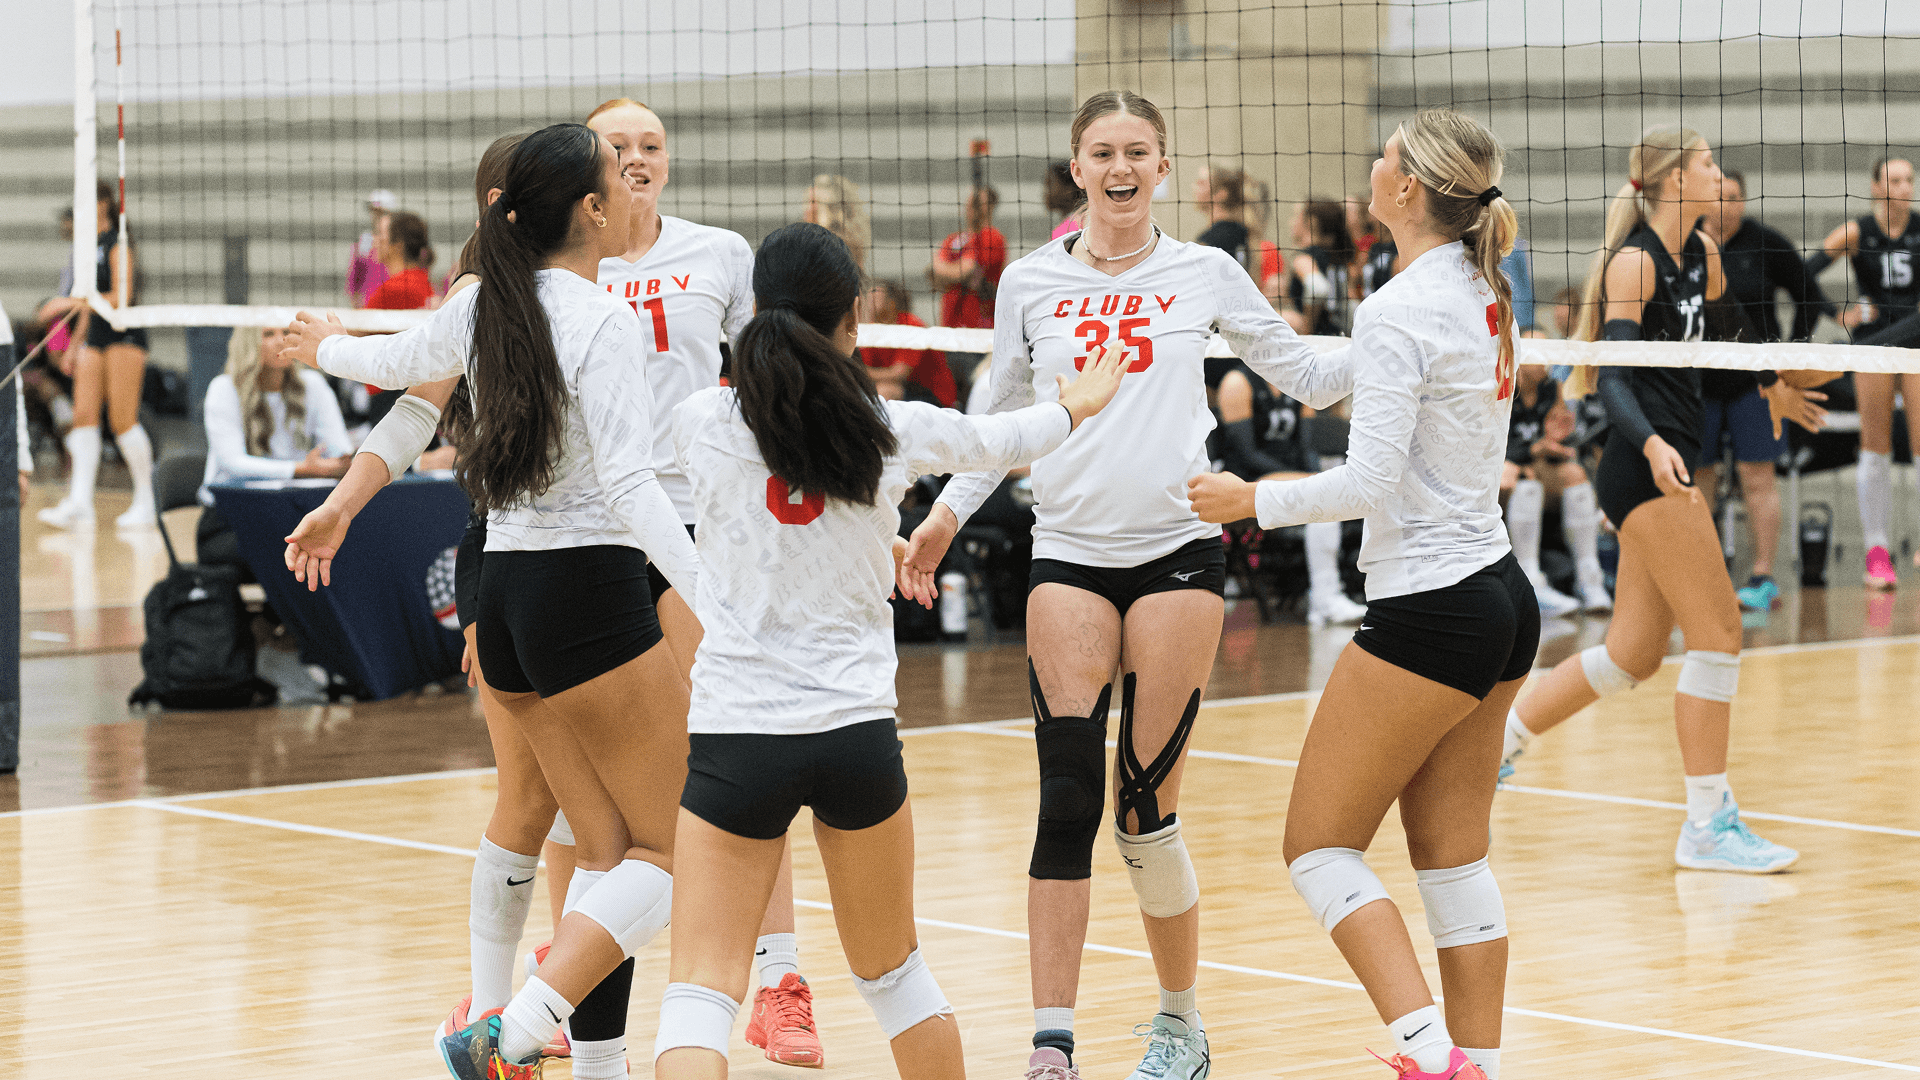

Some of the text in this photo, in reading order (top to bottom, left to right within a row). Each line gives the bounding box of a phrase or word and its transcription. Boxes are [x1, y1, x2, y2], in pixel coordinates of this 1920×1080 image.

[1880, 249, 1912, 288] 15
[1054, 295, 1143, 318] CLUB
[1074, 317, 1153, 374] 35
